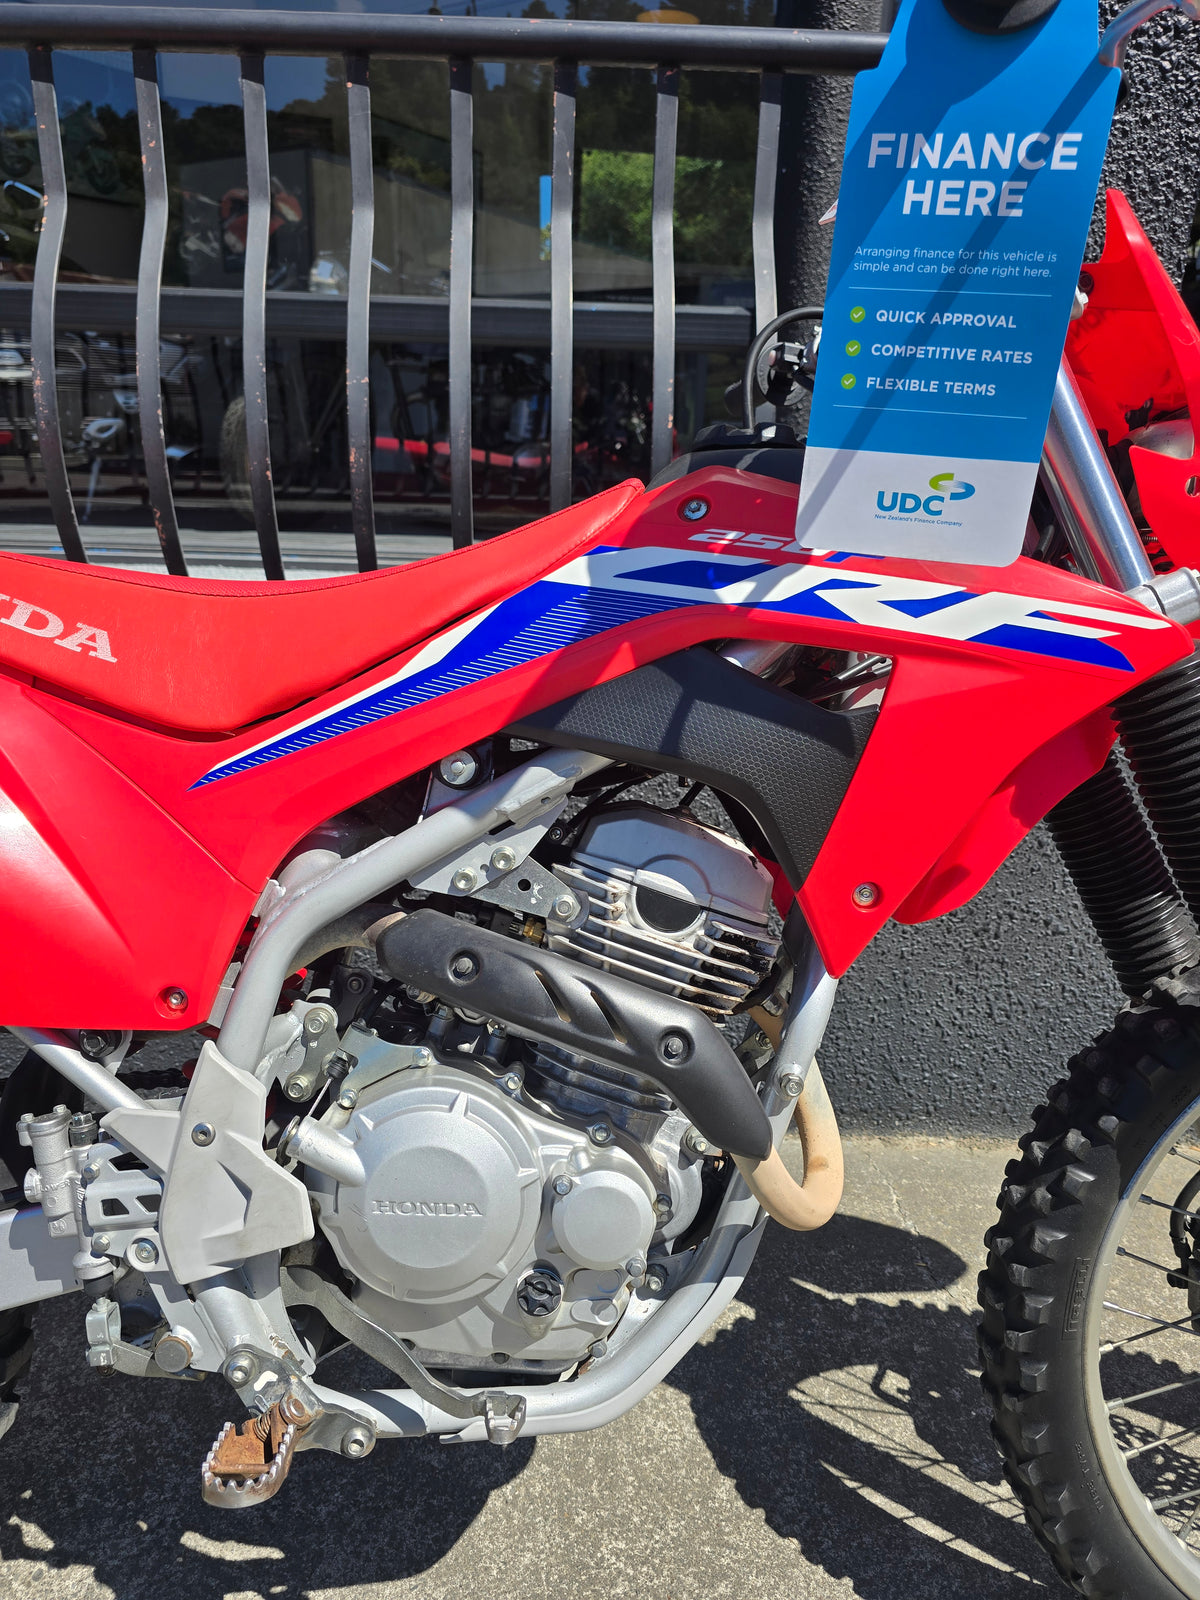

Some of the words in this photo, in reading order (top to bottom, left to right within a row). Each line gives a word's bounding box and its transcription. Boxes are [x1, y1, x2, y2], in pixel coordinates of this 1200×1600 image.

[867, 132, 1083, 171] FINANCE
[902, 179, 1028, 218] HERE
[854, 246, 910, 261] Arranging
[913, 247, 955, 259] finance
[958, 248, 974, 260] for
[978, 249, 999, 261] this
[1002, 250, 1045, 262] vehicle
[1047, 251, 1057, 262] is
[853, 261, 890, 273] simple
[893, 262, 914, 273] and
[917, 264, 938, 274] can
[940, 263, 956, 274] be
[959, 264, 989, 276] done
[991, 265, 1020, 278] right
[1023, 266, 1052, 278] here.
[875, 309, 926, 325] QUICK
[930, 312, 1017, 329] APPROVAL
[871, 343, 977, 362] COMPETITIVE
[981, 349, 1033, 364] RATES
[866, 376, 939, 393] FLEXIBLE
[944, 381, 996, 396] TERMS
[876, 490, 945, 517] UDC
[913, 517, 936, 525] Finance
[936, 519, 963, 528] Company
[0, 593, 118, 663] DA
[371, 1200, 483, 1217] HONDA
